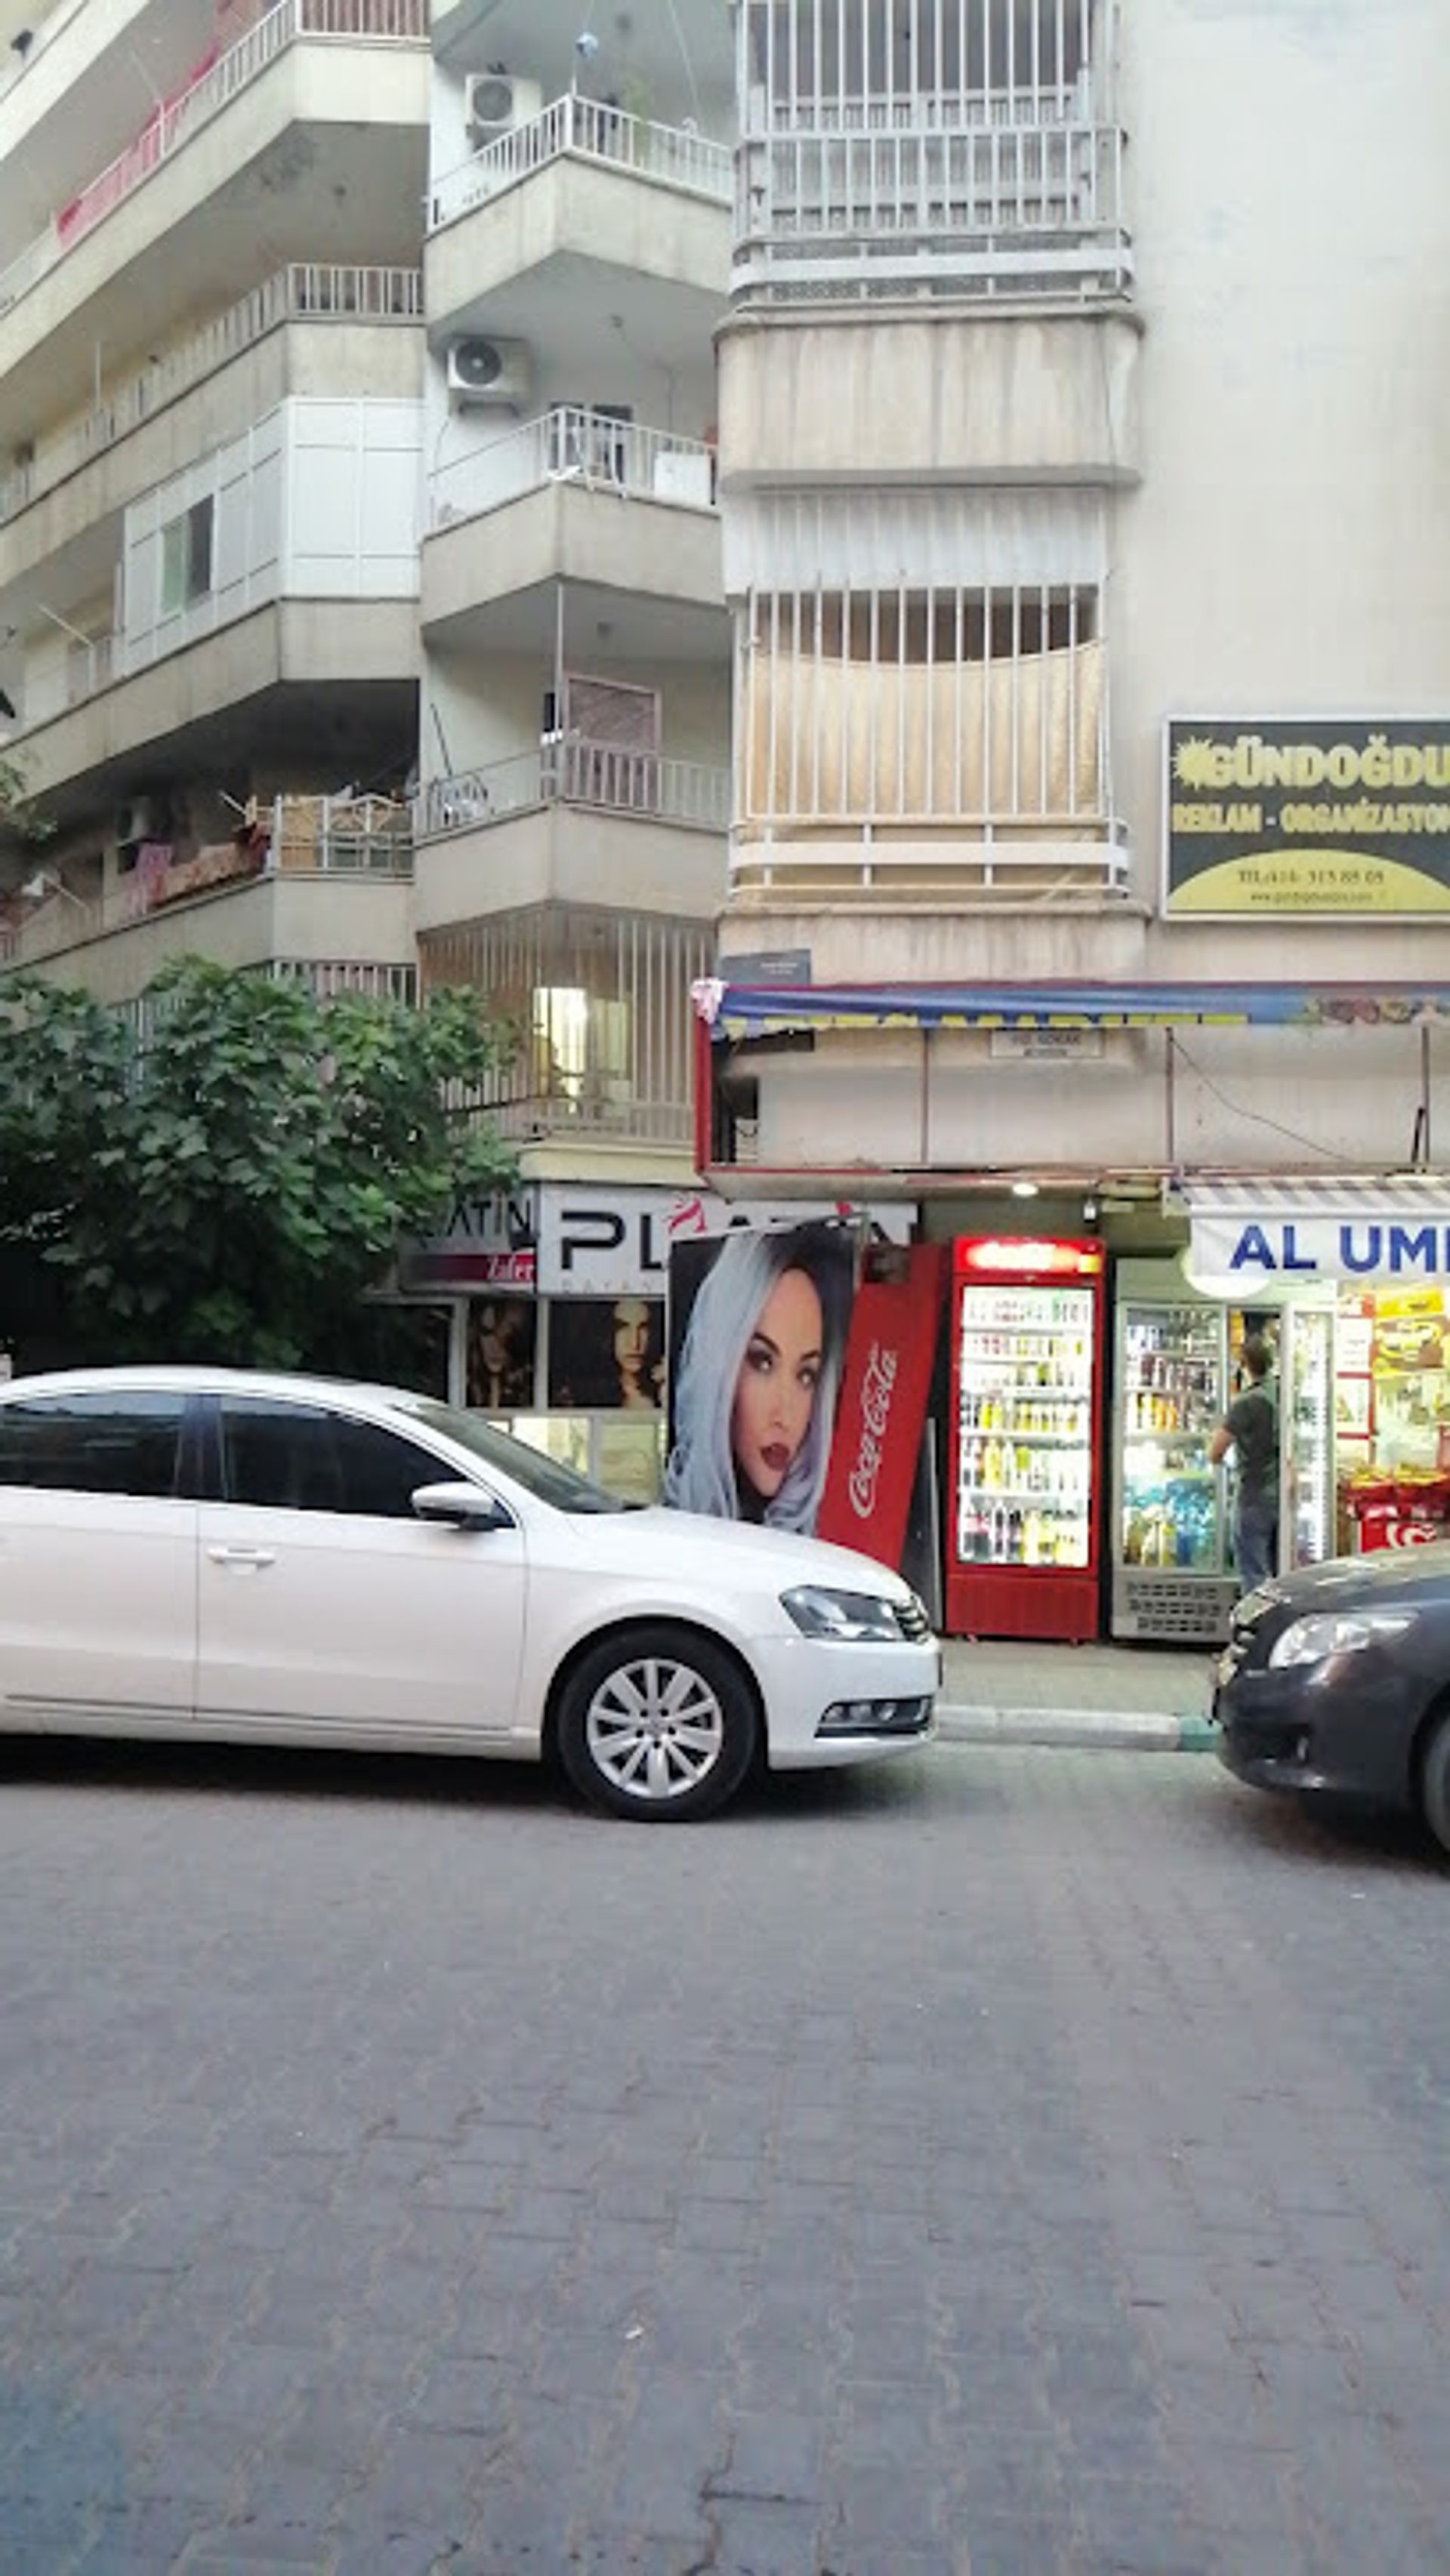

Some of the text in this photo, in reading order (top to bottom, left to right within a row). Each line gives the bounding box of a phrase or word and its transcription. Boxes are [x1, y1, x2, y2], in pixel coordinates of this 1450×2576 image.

[1209, 735, 1450, 789] GÜNDOĞDU
[1172, 803, 1262, 832] REKLAM
[1229, 1225, 1317, 1270] AL
